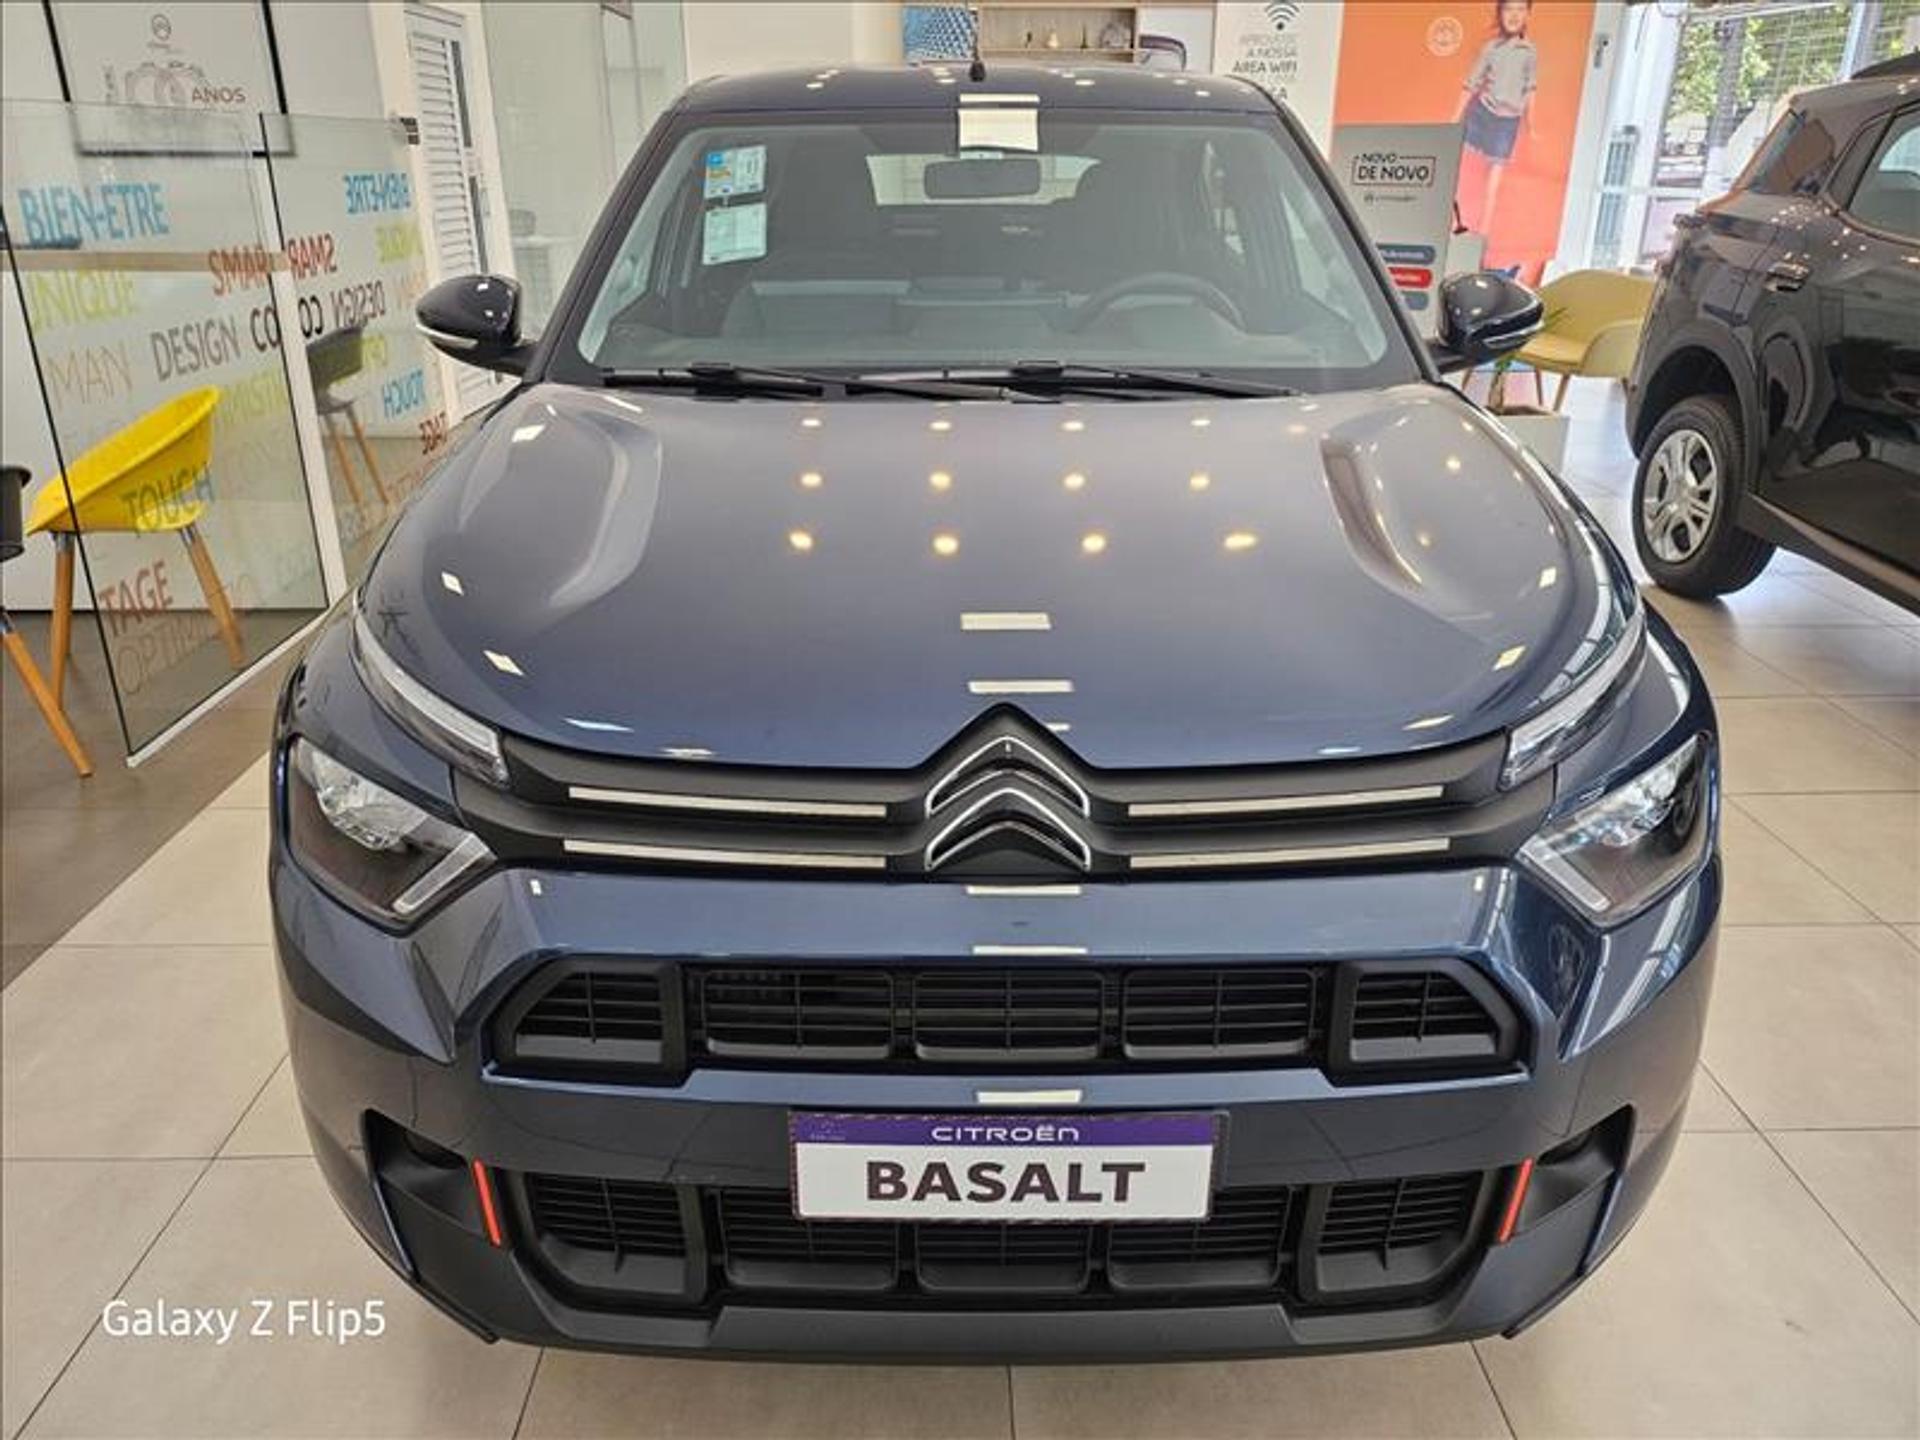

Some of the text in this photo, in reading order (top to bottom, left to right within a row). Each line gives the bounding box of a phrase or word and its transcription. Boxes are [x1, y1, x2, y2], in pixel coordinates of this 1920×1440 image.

[1358, 166, 1429, 180] DE NOVO
[1361, 153, 1397, 163] NOVO
[151, 315, 241, 382] DESIGN
[119, 460, 216, 537] TOUCH
[866, 1161, 1146, 1203] BASALT
